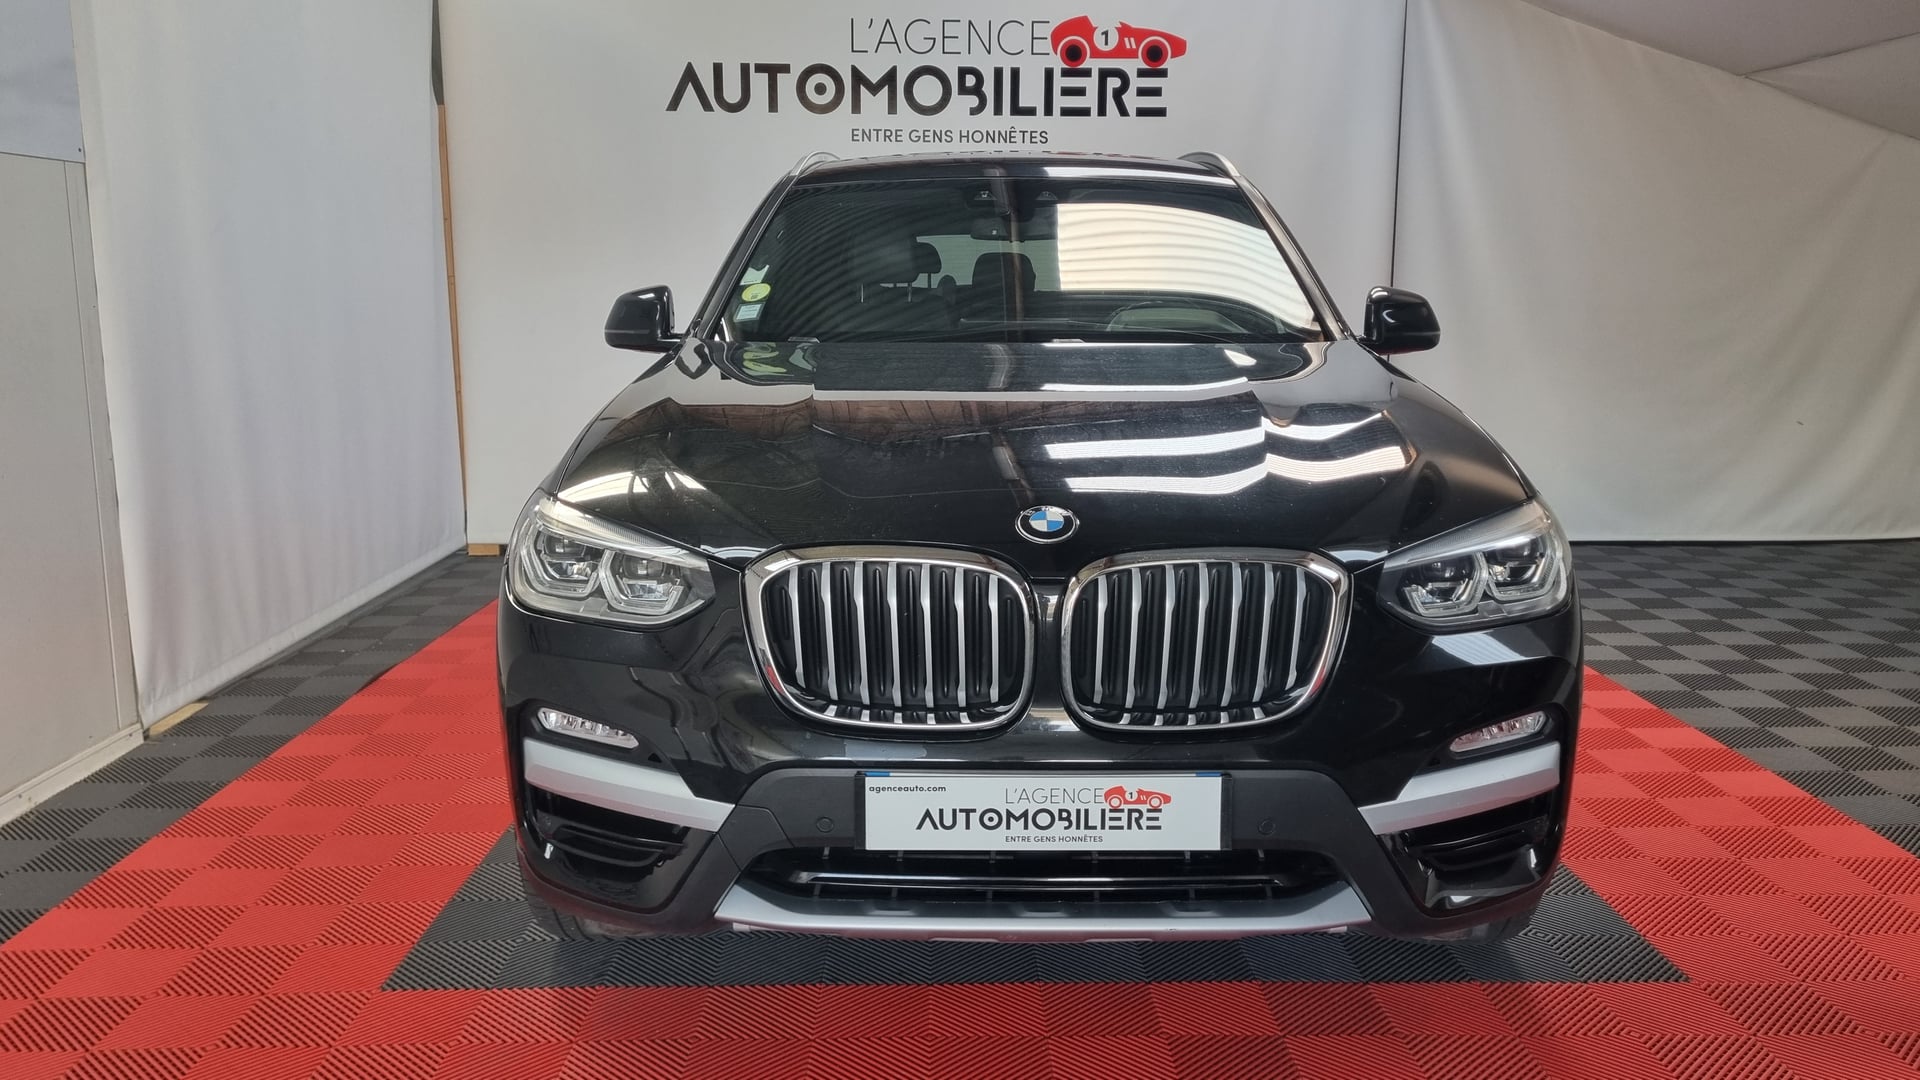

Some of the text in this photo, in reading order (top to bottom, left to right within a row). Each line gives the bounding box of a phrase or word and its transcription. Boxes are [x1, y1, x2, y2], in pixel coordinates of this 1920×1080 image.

[850, 17, 1050, 56] L'AGENCE
[1099, 29, 1110, 47] 1
[851, 126, 1049, 145] ENTRE GENS HONNÊTES
[868, 785, 947, 793] agenceauto.com
[1005, 787, 1104, 805] L'AGENCE
[1128, 791, 1134, 800] 1
[1005, 834, 1103, 843] ENTRE GENS HONNÊTES
